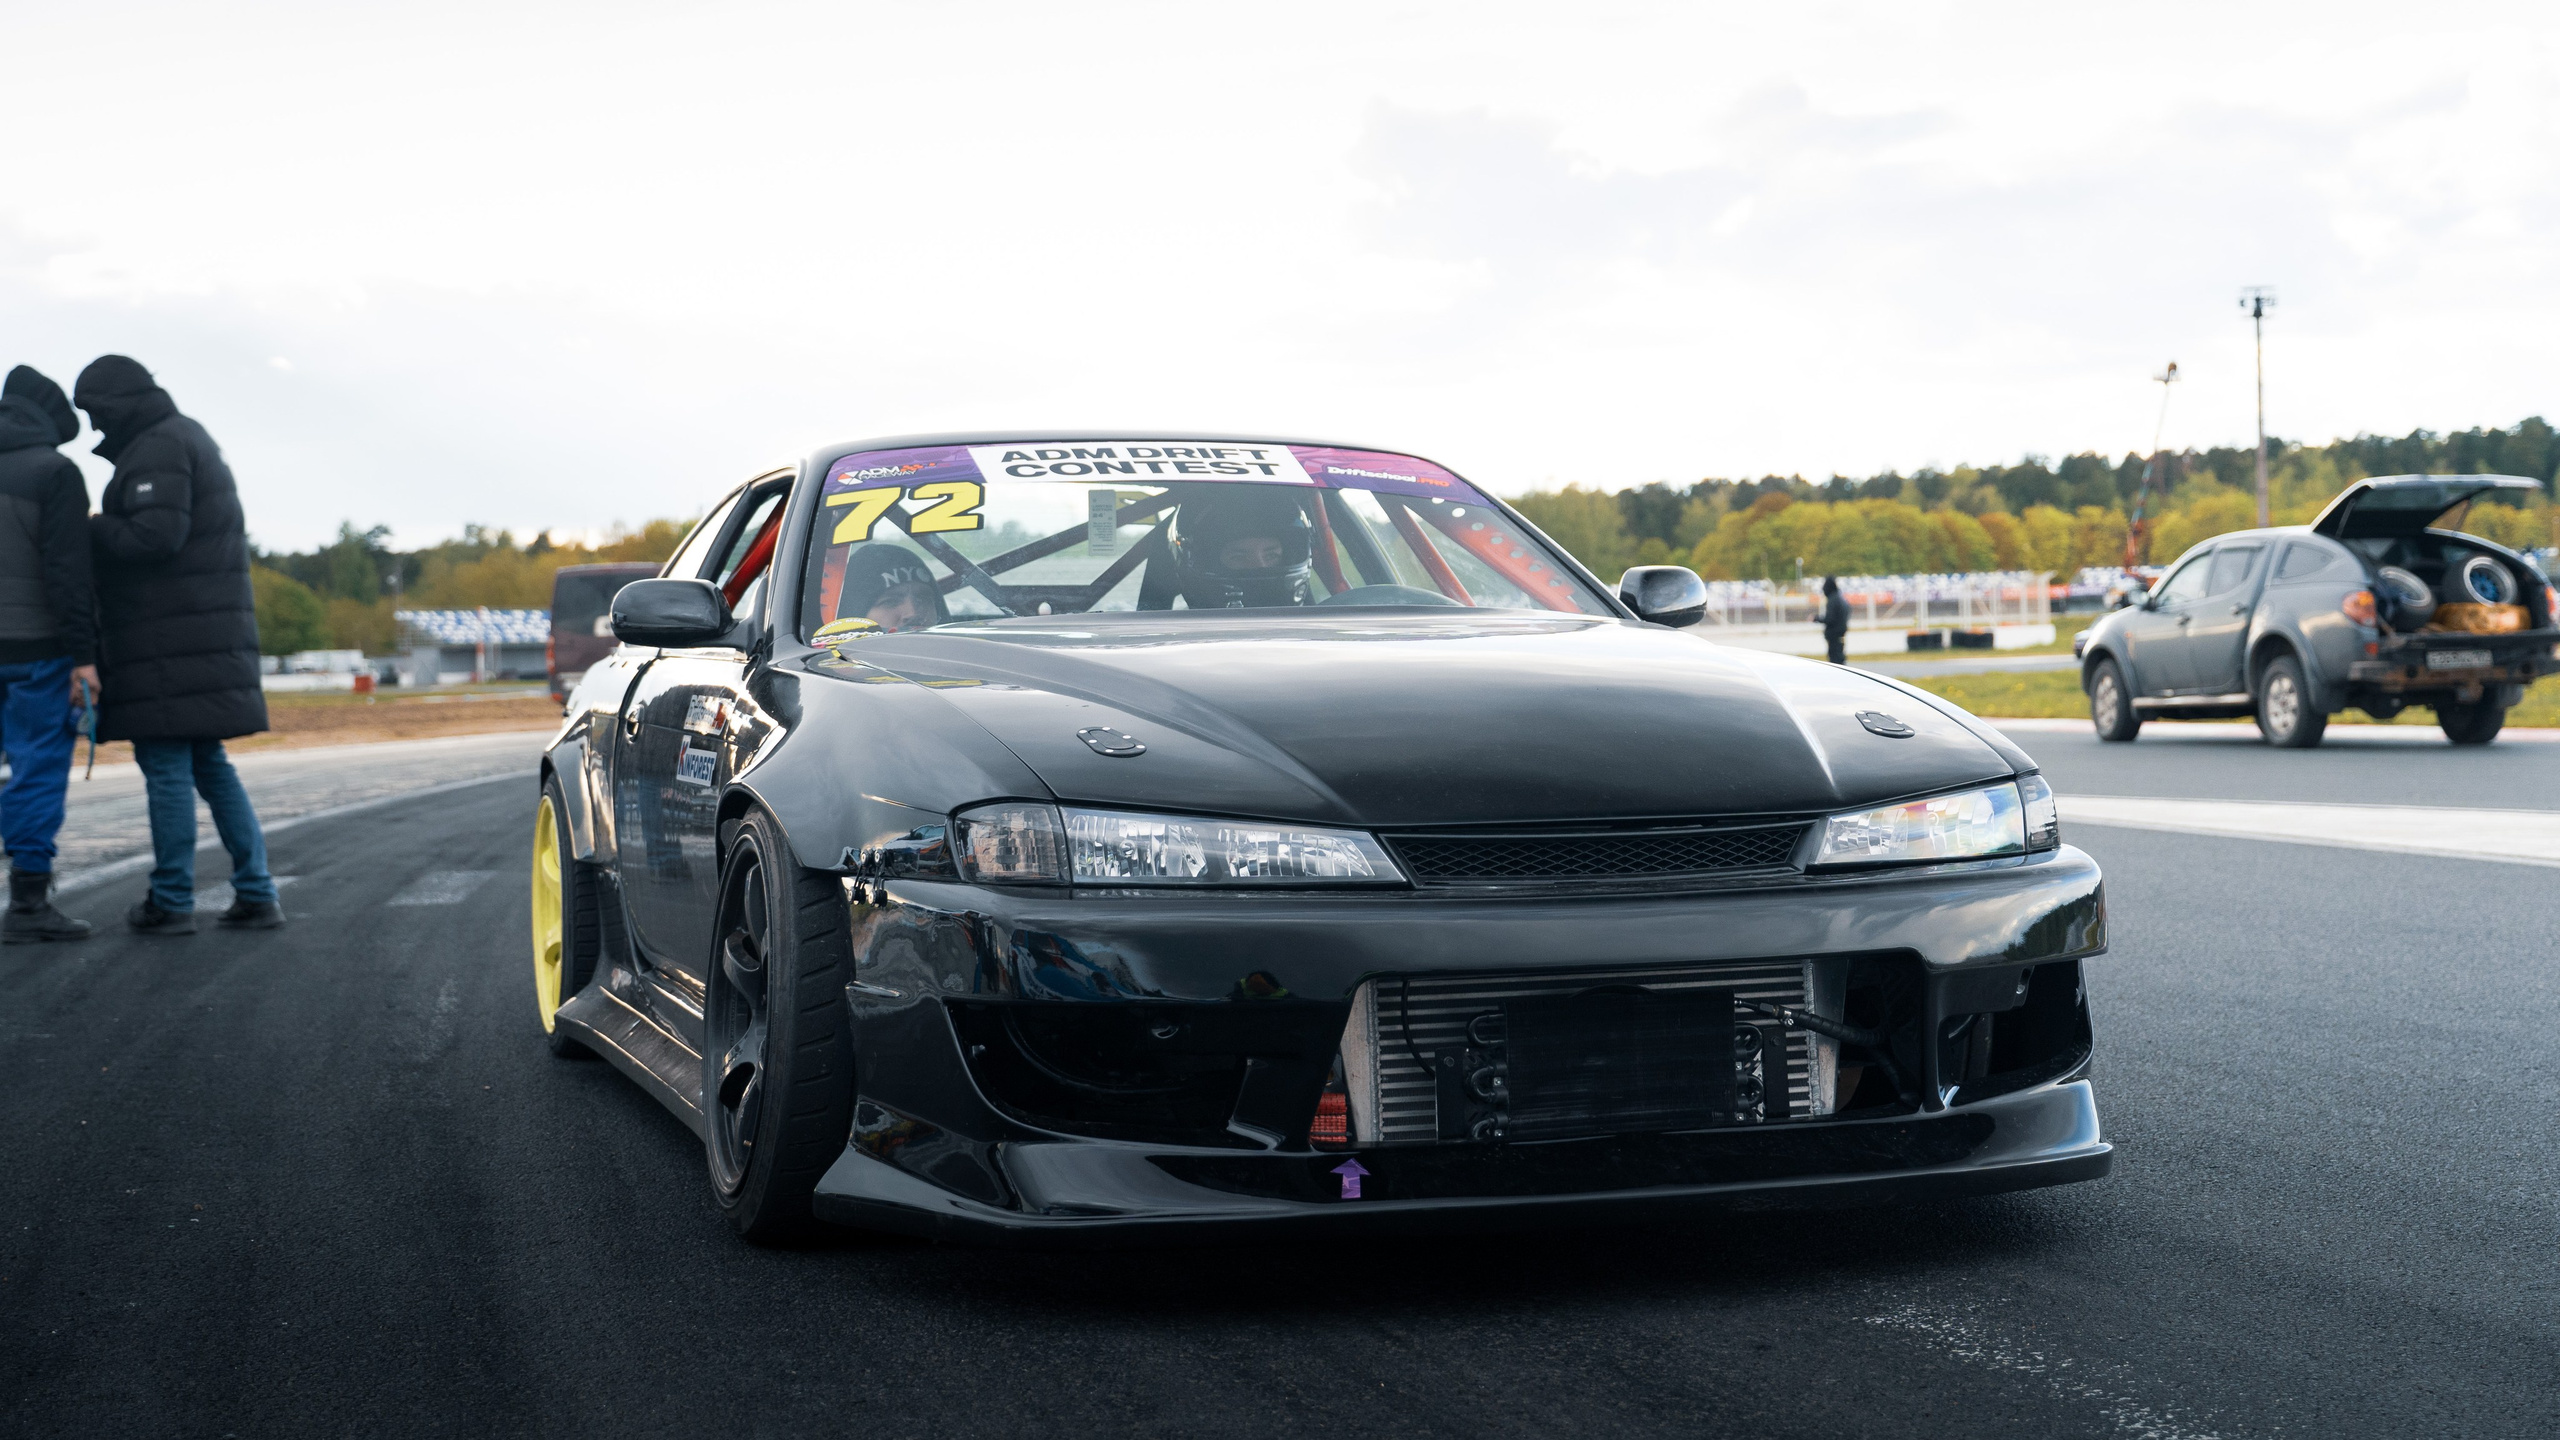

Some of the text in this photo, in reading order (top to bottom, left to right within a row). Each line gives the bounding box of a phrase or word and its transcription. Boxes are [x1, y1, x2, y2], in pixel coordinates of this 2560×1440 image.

[1001, 447, 1270, 463] ADM DRIFT
[859, 465, 900, 476] ADM
[1005, 460, 1280, 478] CONTEST
[824, 481, 985, 545] 72
[678, 741, 715, 781] KINFOREST
